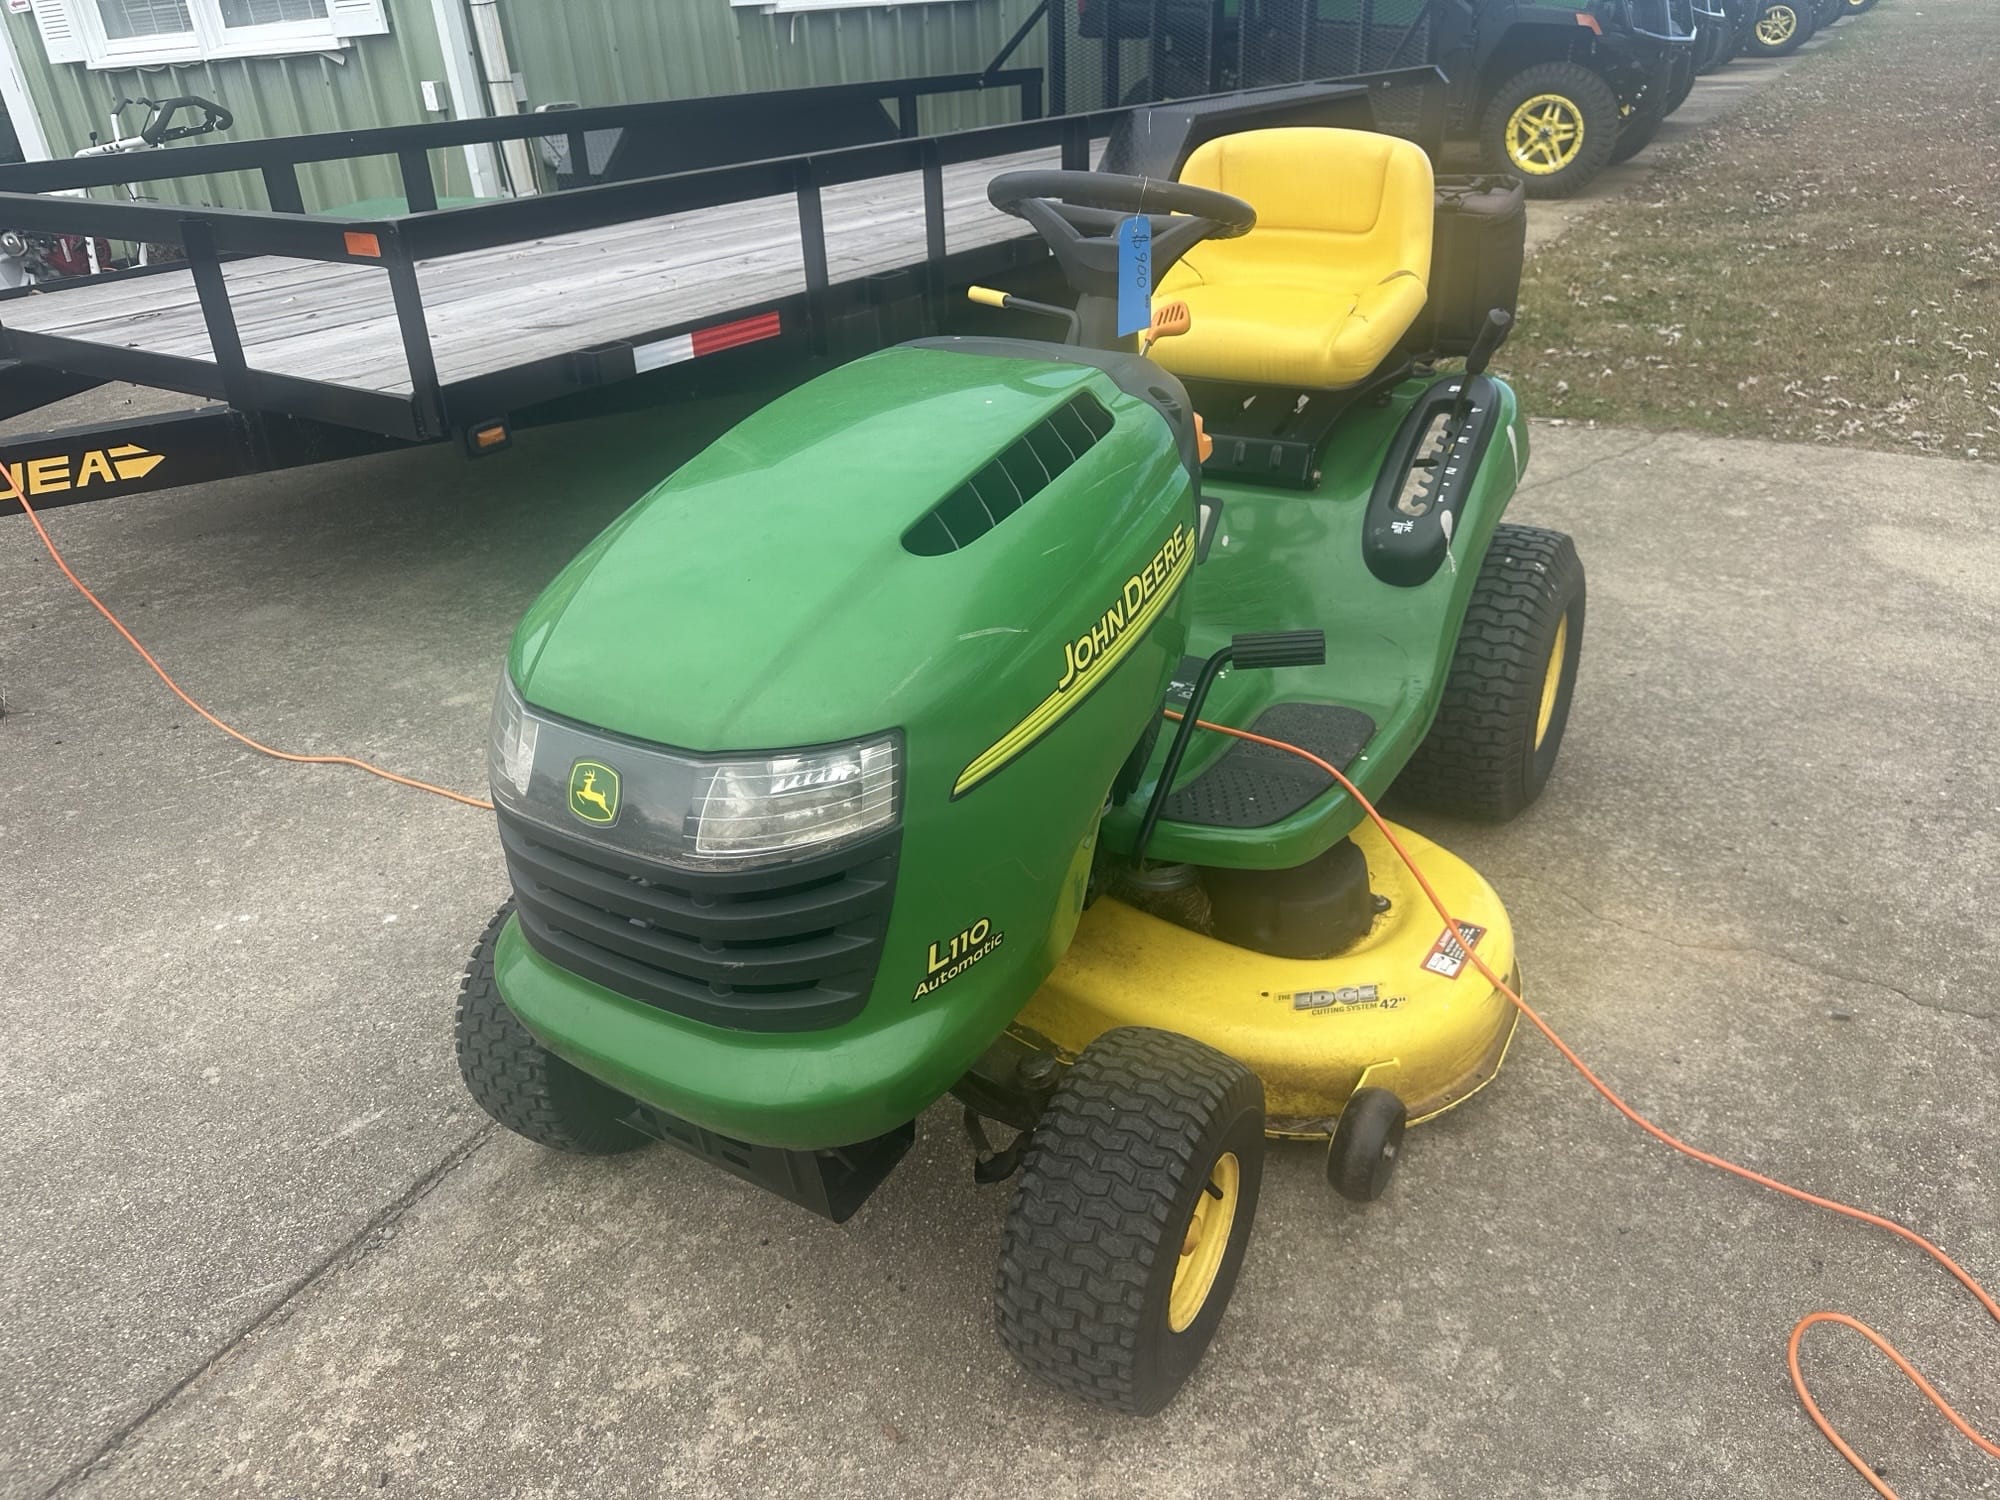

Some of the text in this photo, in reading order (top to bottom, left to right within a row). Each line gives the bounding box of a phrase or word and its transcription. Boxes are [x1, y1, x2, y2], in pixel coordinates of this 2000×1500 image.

[1057, 522, 1187, 692] JOHN DEERE
[913, 932, 1004, 1001] Automatic
[927, 918, 990, 975] L110
[1278, 984, 1380, 1011] THE EDGE
[1311, 1007, 1345, 1016] CUTTING
[1346, 1003, 1378, 1012] SYSTEM
